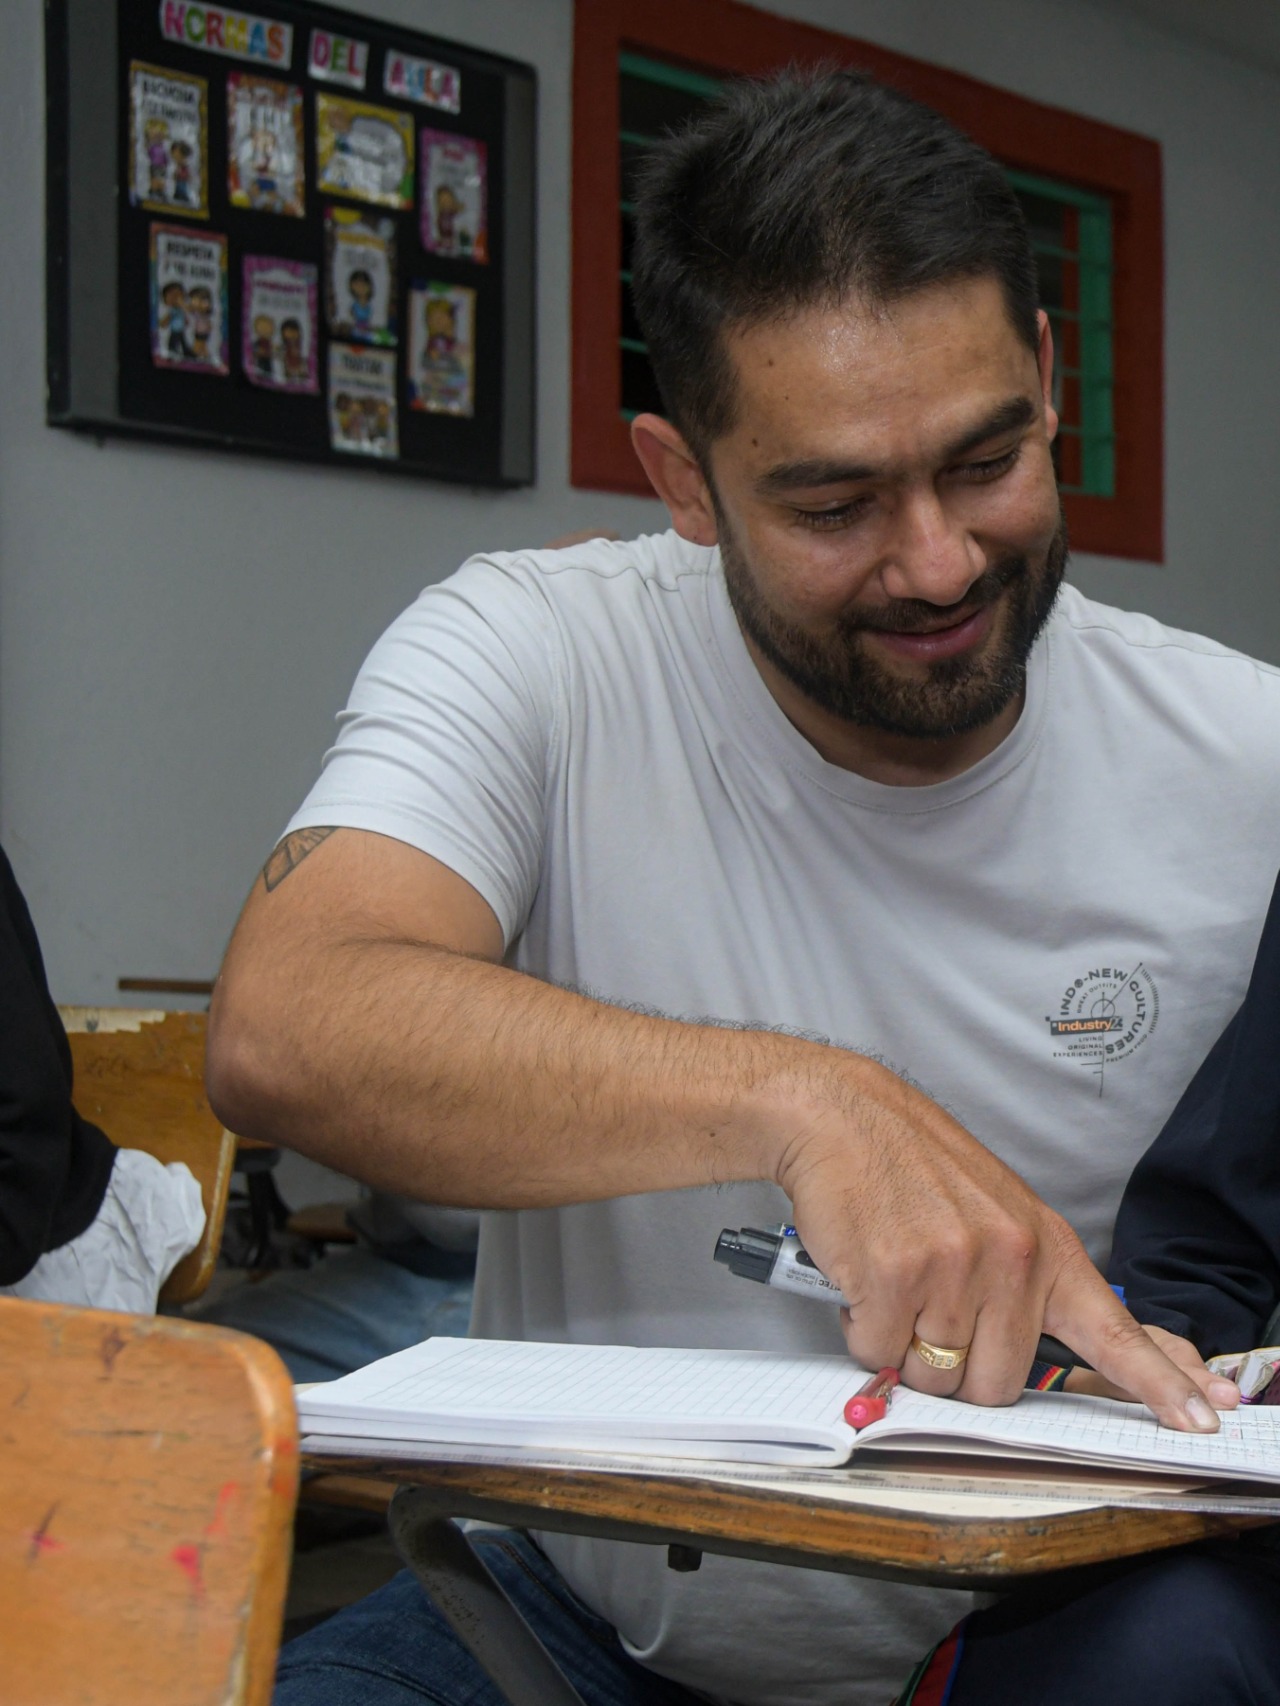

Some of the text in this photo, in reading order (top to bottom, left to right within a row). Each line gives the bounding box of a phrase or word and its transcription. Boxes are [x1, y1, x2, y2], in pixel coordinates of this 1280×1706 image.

[163, 1, 457, 103] NORMAS DEL AULA
[1079, 1035, 1103, 1043] LIVING
[1105, 980, 1146, 1055] CULTURES
